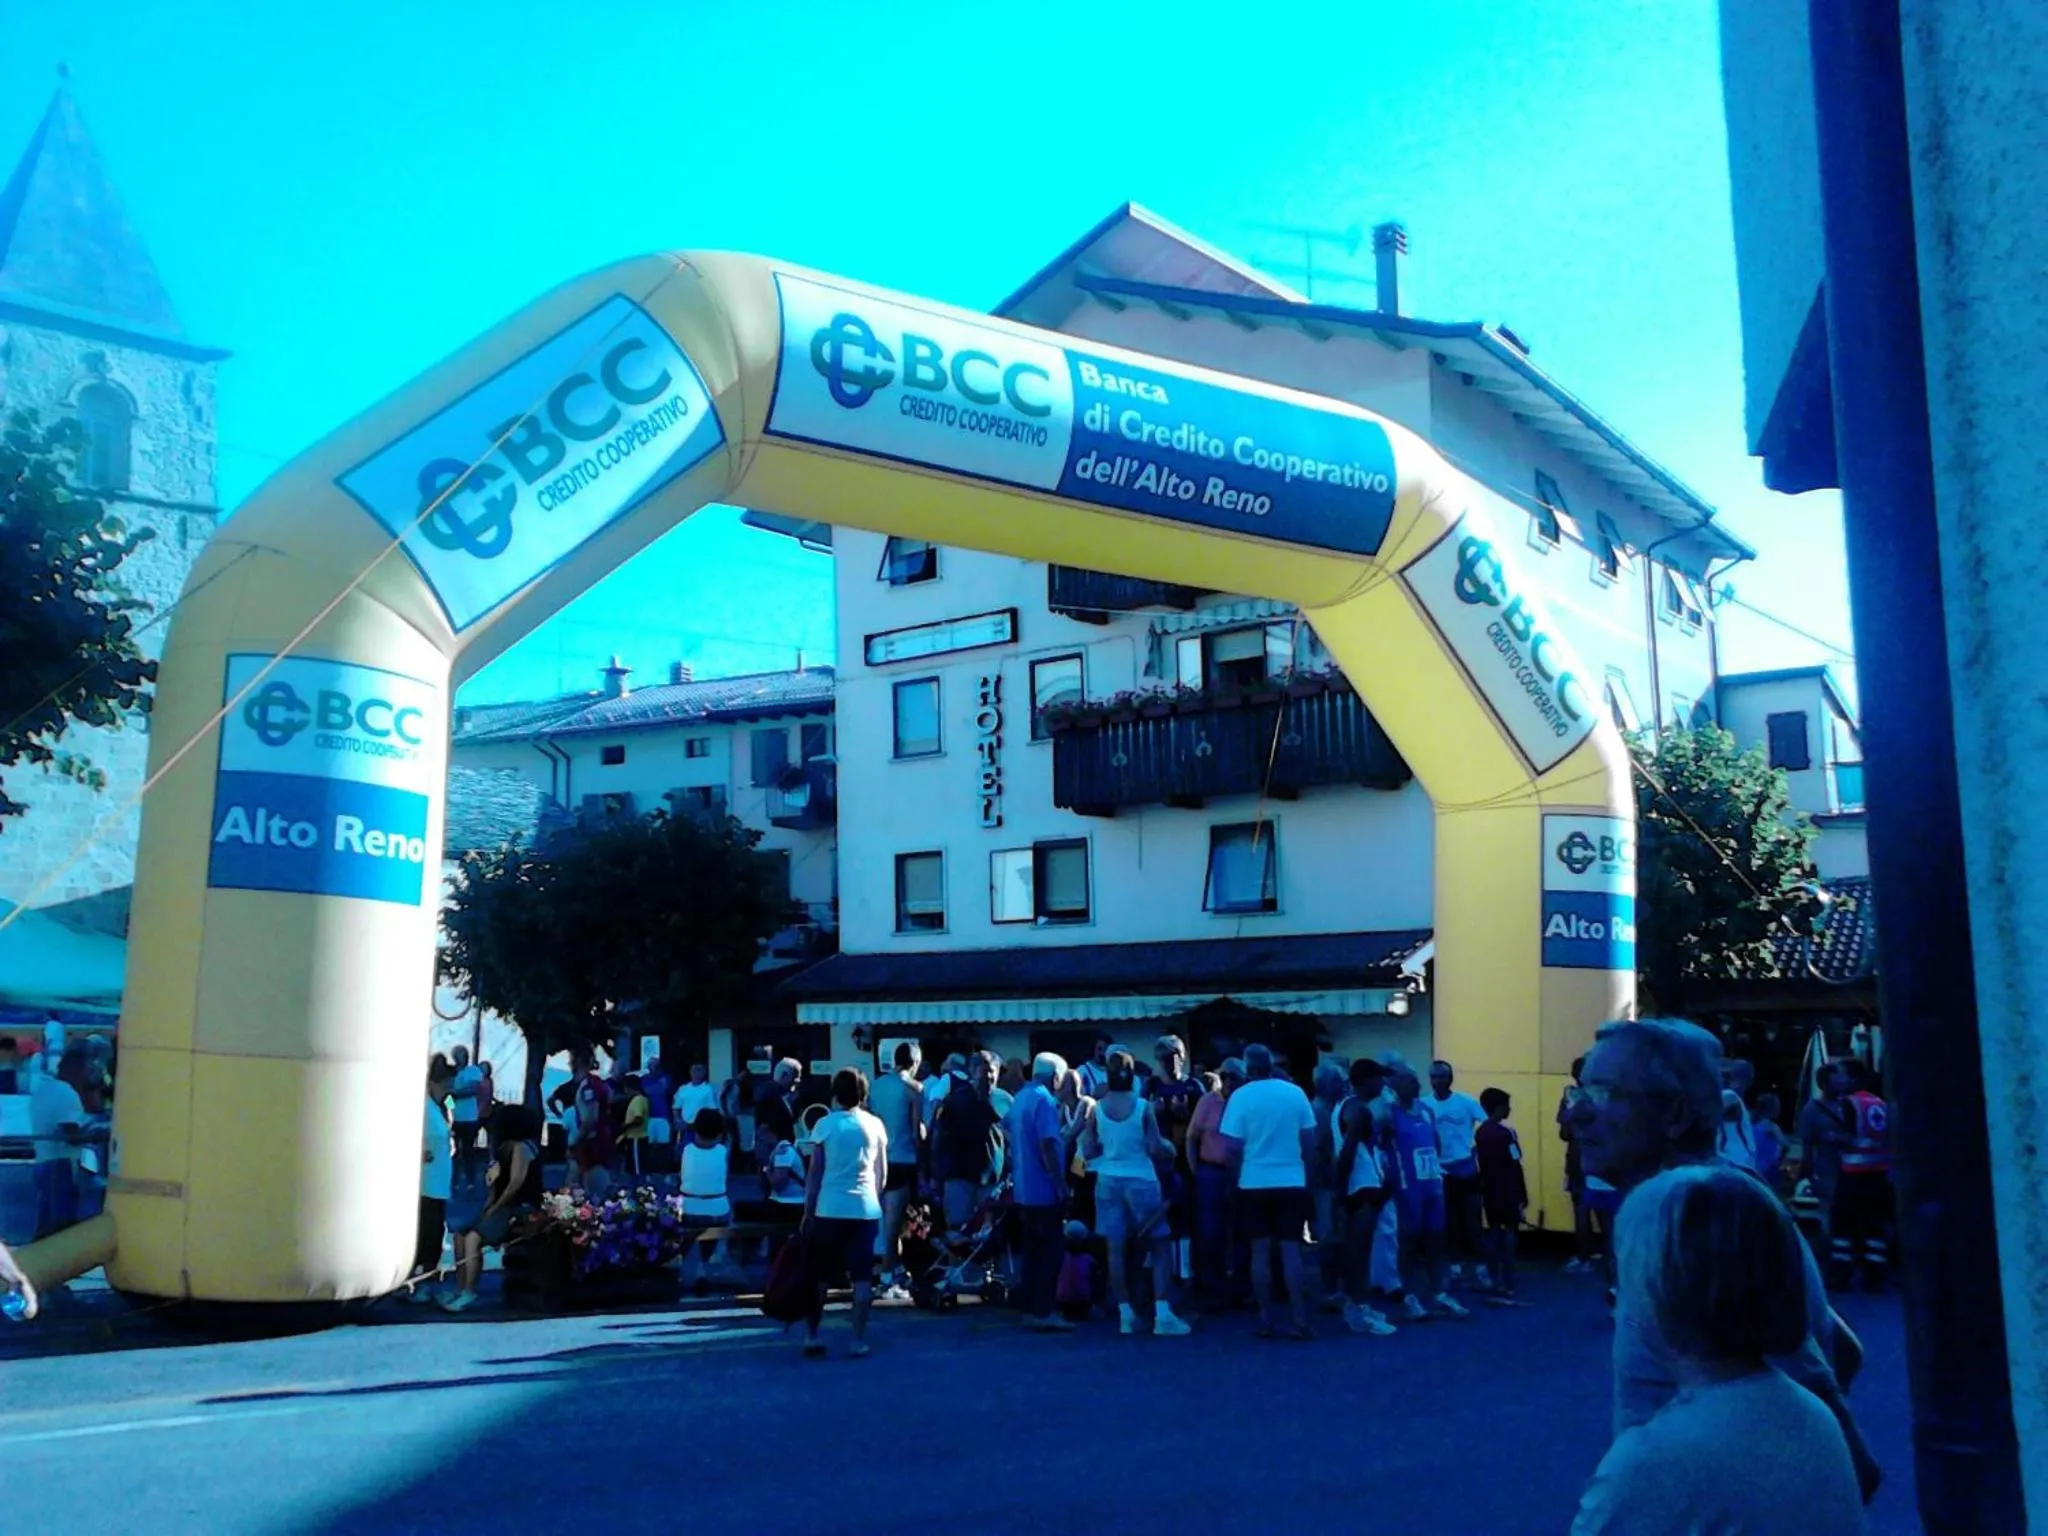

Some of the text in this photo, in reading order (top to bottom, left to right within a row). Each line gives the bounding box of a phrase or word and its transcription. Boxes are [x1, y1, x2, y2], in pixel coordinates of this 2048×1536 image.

[487, 336, 673, 486] BCC
[902, 332, 1052, 418] BCC
[1078, 361, 1169, 404] Banca
[536, 394, 689, 512] CREDITO COOPERATIVO
[900, 394, 1048, 448] CREDITO COOPERATIVO
[1083, 402, 1389, 494] di Credito Cooperativo
[1075, 451, 1272, 516] dell'Alto Reno
[1486, 621, 1570, 738] CREDITO COOPERATIVO
[1502, 593, 1583, 723] BCC
[315, 690, 424, 746] BCC
[214, 805, 425, 864] Alto Reno
[1544, 913, 1606, 940] Alto
